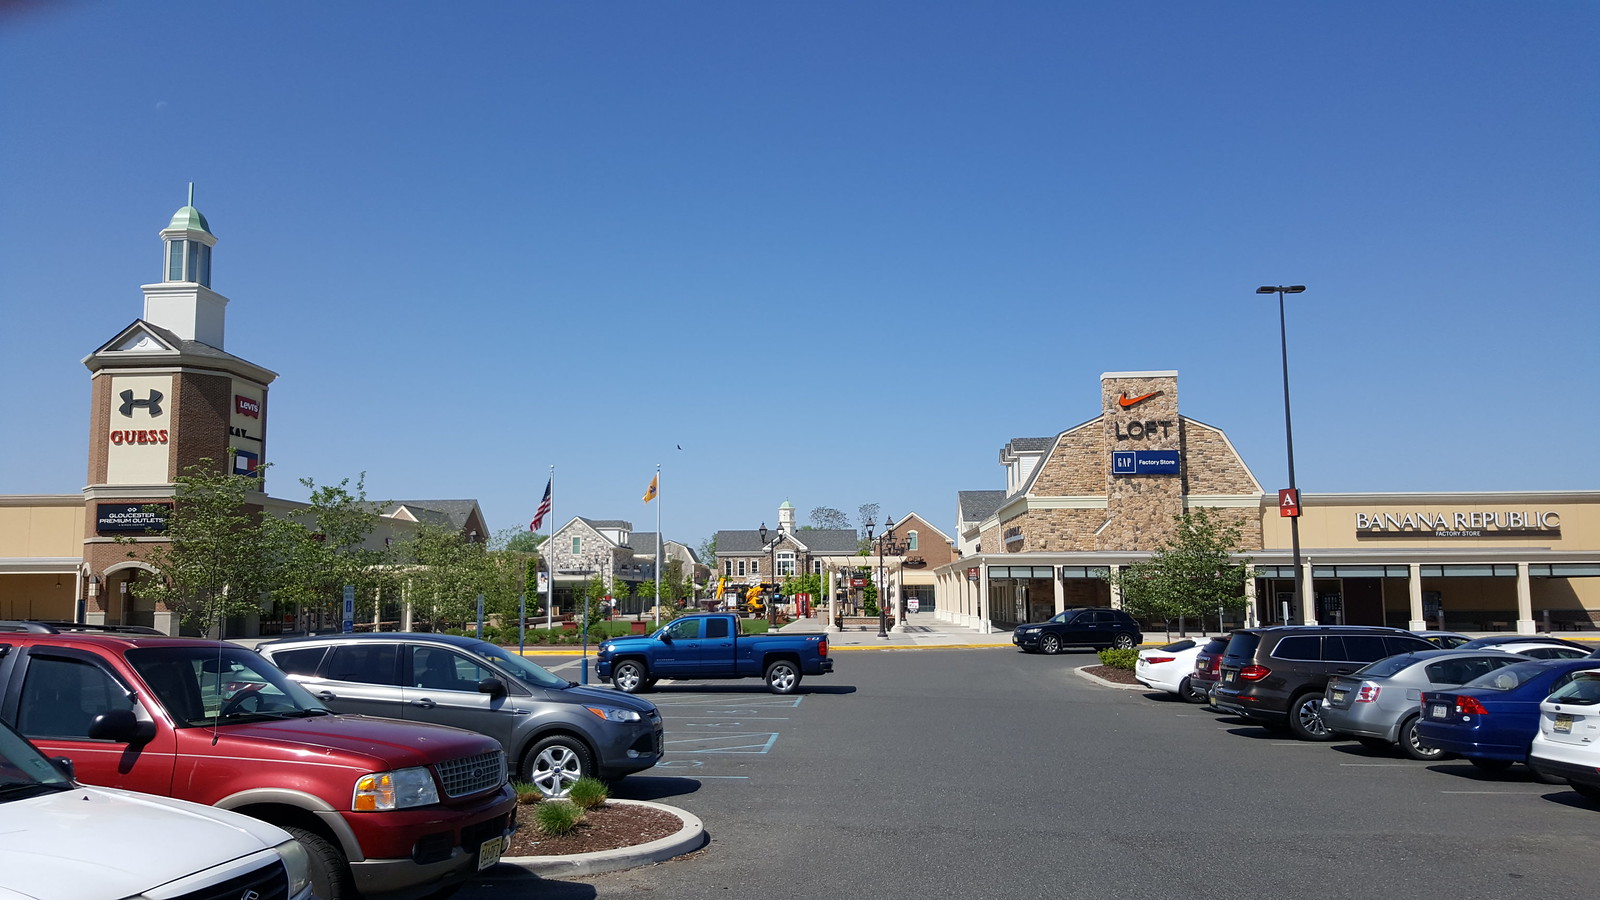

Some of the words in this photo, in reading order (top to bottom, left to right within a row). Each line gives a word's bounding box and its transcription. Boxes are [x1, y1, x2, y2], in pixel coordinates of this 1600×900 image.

[110, 429, 169, 445] GUESS
[229, 426, 247, 438] KAY
[1115, 421, 1173, 441] LOFT
[1118, 457, 1131, 467] GAP
[1282, 493, 1295, 506] A
[1356, 512, 1449, 530] BANANA
[1453, 511, 1561, 529] REPUBLIC
